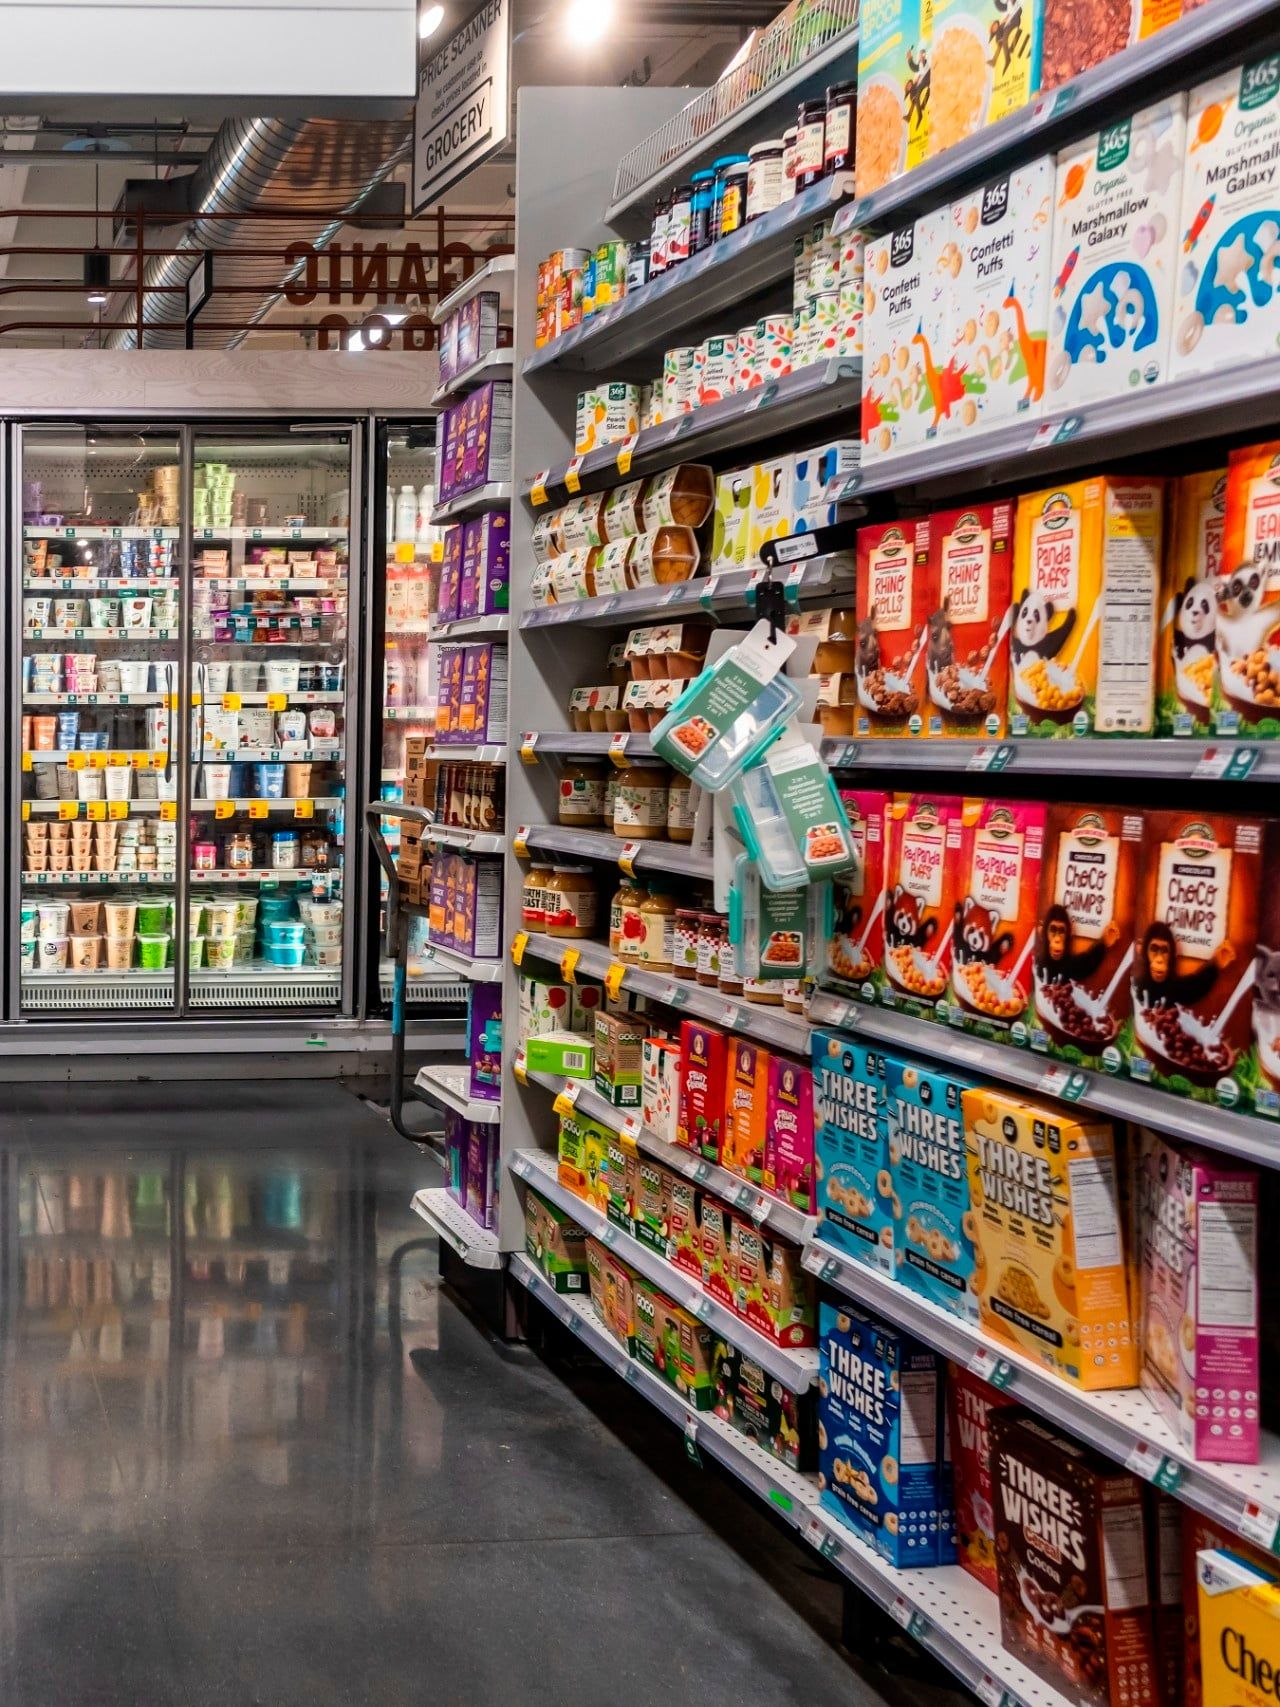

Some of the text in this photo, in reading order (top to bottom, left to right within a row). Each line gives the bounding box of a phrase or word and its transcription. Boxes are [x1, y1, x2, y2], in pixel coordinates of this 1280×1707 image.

[420, 0, 502, 92] PRICE SCANNER
[442, 64, 466, 94] customer
[461, 67, 481, 94] located
[1243, 58, 1280, 95] 365
[425, 97, 486, 173] GROCERY
[1100, 124, 1128, 157] 365
[1234, 112, 1277, 138] Organic
[1225, 136, 1260, 157] GLUTEN
[1206, 140, 1280, 186] Marshmall
[1093, 174, 1128, 198] Organic
[1226, 167, 1276, 195] Galaxy
[983, 182, 1009, 213] 365
[1086, 187, 1134, 212] GLUTEN FREE
[1071, 197, 1150, 238] Marshmallow
[892, 228, 913, 255] 365
[970, 229, 1015, 263] Confetti
[1087, 222, 1128, 247] Galaxy
[977, 256, 1004, 279] Puffs
[882, 273, 921, 302] Confetti
[888, 297, 912, 318] Puffs
[610, 387, 625, 397] 365
[606, 415, 626, 424] Peach
[606, 423, 626, 431] Slices
[821, 1068, 878, 1116] THREE
[822, 1098, 878, 1142] WISHES
[895, 1098, 962, 1152] THREE
[898, 1131, 962, 1180] WISHES
[976, 1133, 1052, 1196] THREE
[979, 1169, 1055, 1227] WISHES
[940, 1267, 963, 1288] cereal
[1014, 1312, 1031, 1329] free
[1031, 1320, 1058, 1344] cereal
[829, 1339, 886, 1400] THREE
[828, 1368, 885, 1427] WISHES
[1005, 1453, 1078, 1525] THREE
[999, 1482, 1087, 1573] WISHES
[1026, 1548, 1061, 1585] Cocoa
